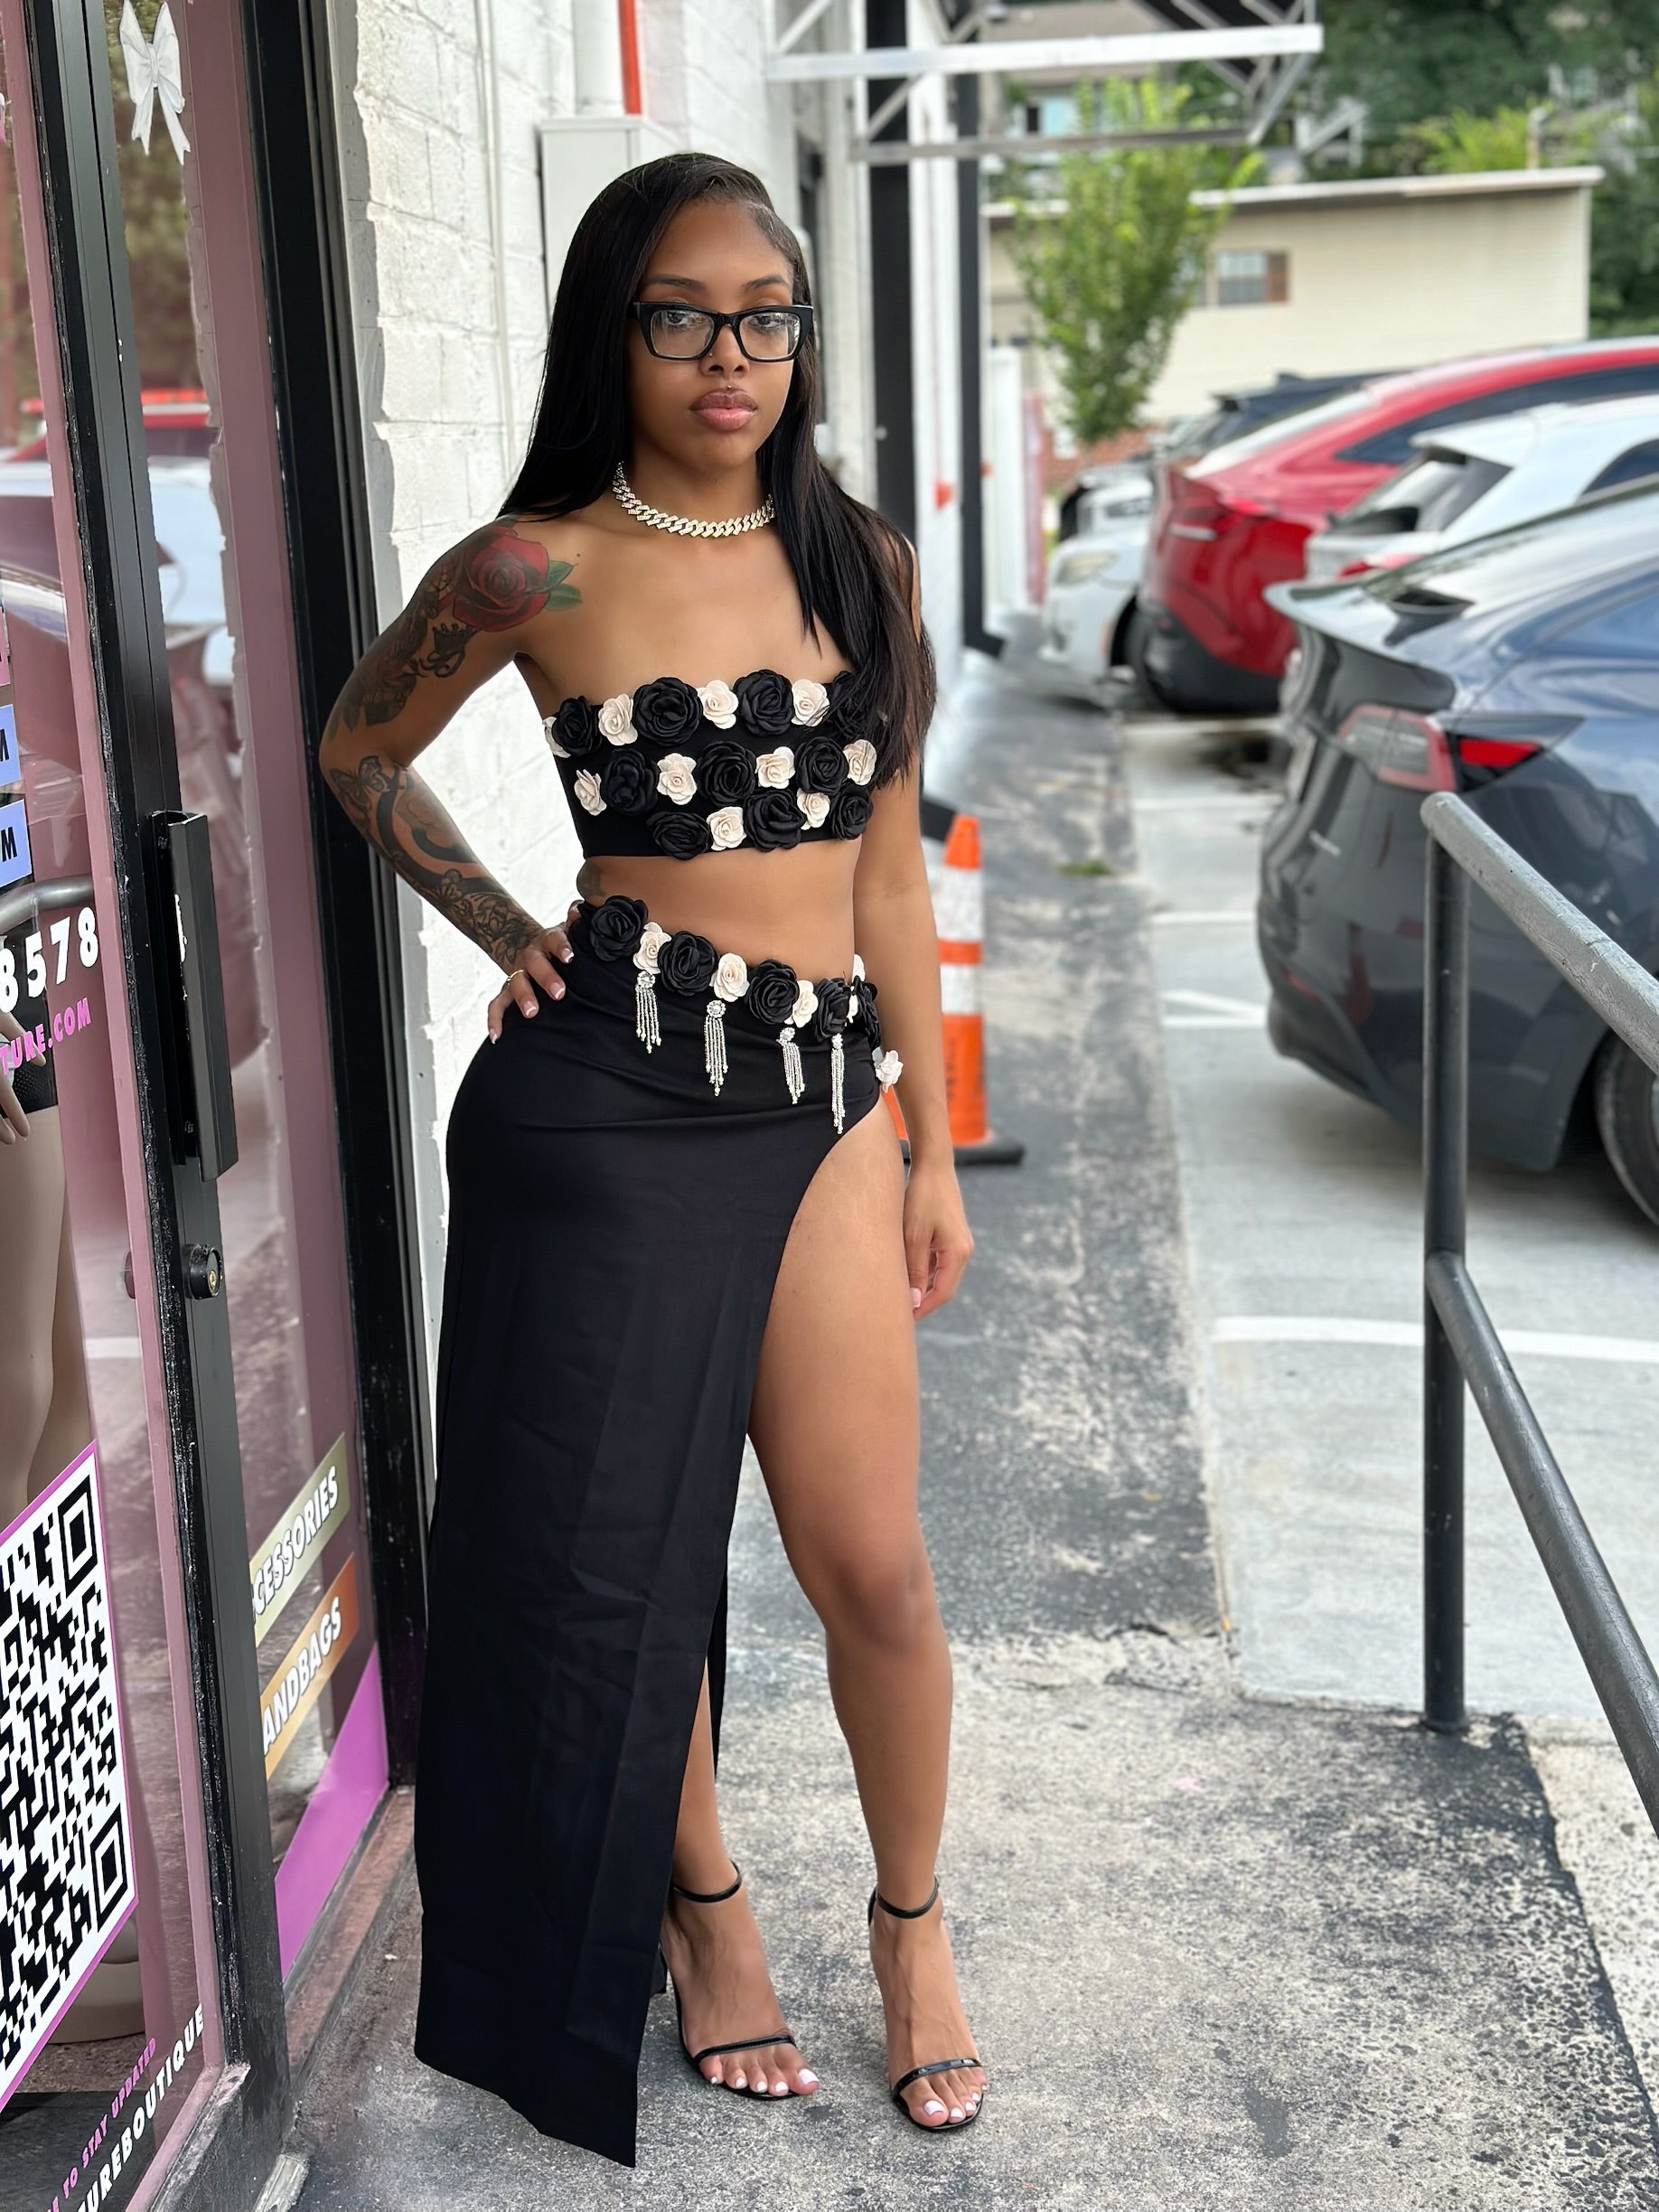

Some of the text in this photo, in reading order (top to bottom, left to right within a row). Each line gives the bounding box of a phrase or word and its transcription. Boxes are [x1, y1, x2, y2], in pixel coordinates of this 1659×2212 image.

[0, 906, 99, 1013] 8578
[0, 997, 91, 1075] TURE.COM
[252, 1465, 338, 1625] CESSORIES
[81, 2114, 108, 2169] STAY
